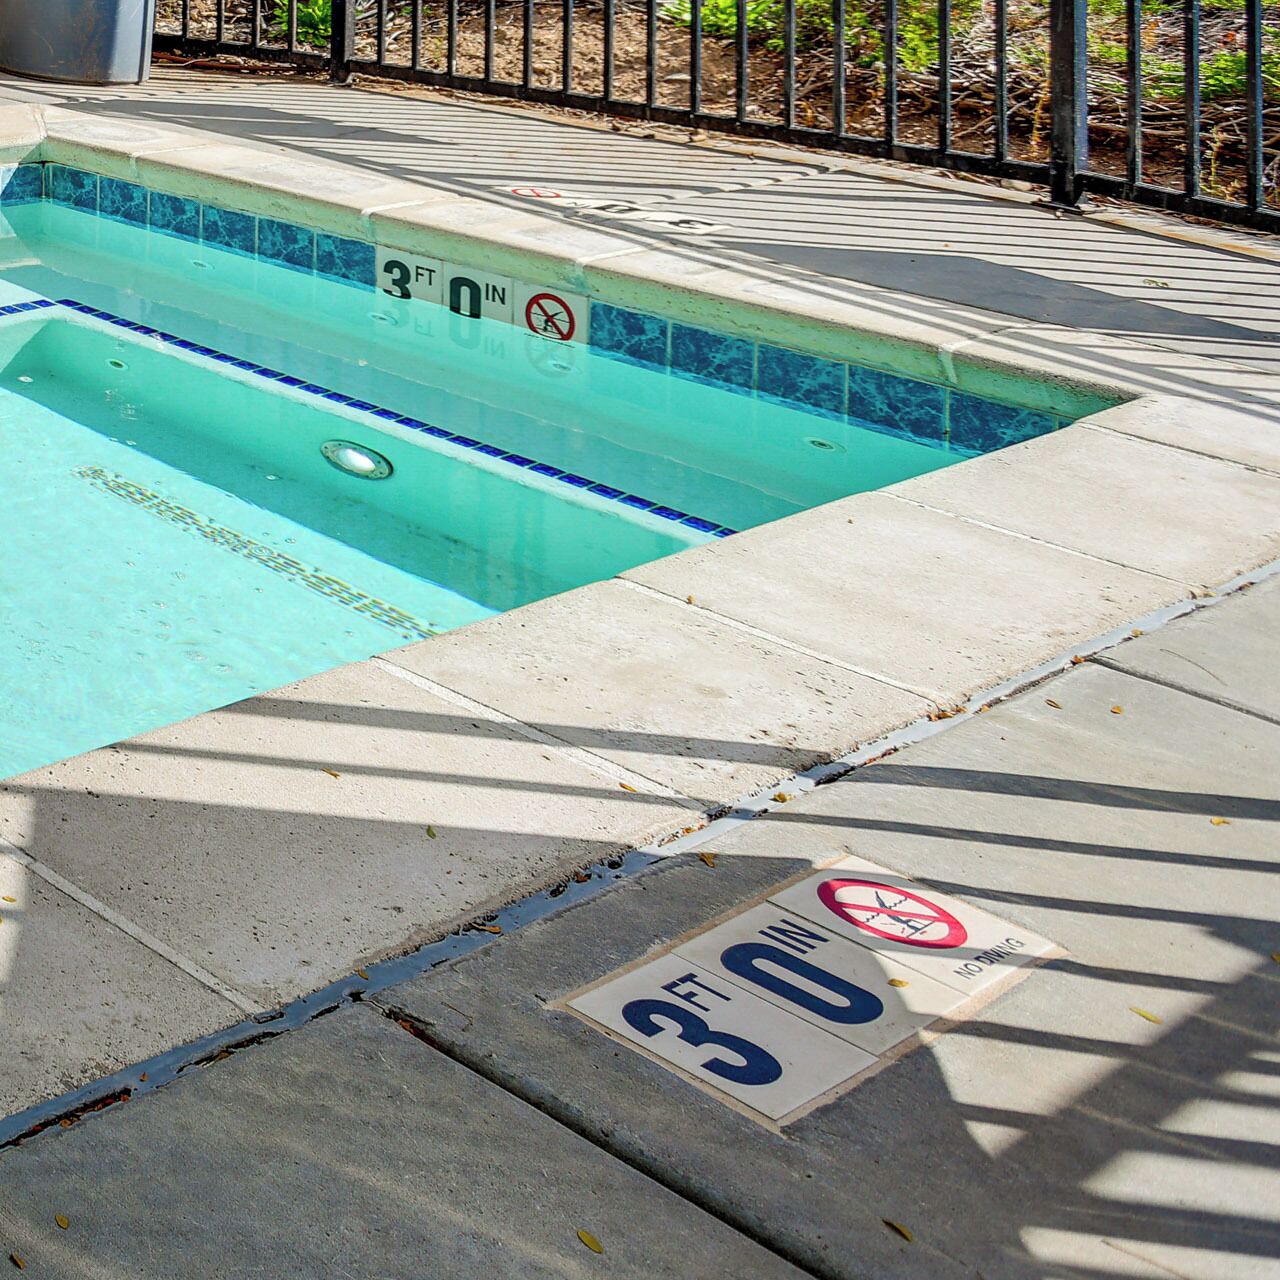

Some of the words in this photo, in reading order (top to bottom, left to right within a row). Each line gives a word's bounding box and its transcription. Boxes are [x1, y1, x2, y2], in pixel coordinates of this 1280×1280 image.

[383, 259, 412, 300] 3
[415, 265, 436, 286] FT
[449, 276, 481, 320] 0
[485, 283, 506, 305] IN
[758, 918, 830, 955] IN
[953, 962, 984, 980] NO
[973, 937, 1026, 967] DIVING
[660, 972, 732, 1012] FT
[720, 942, 884, 1025] 0
[622, 999, 783, 1085] 3
